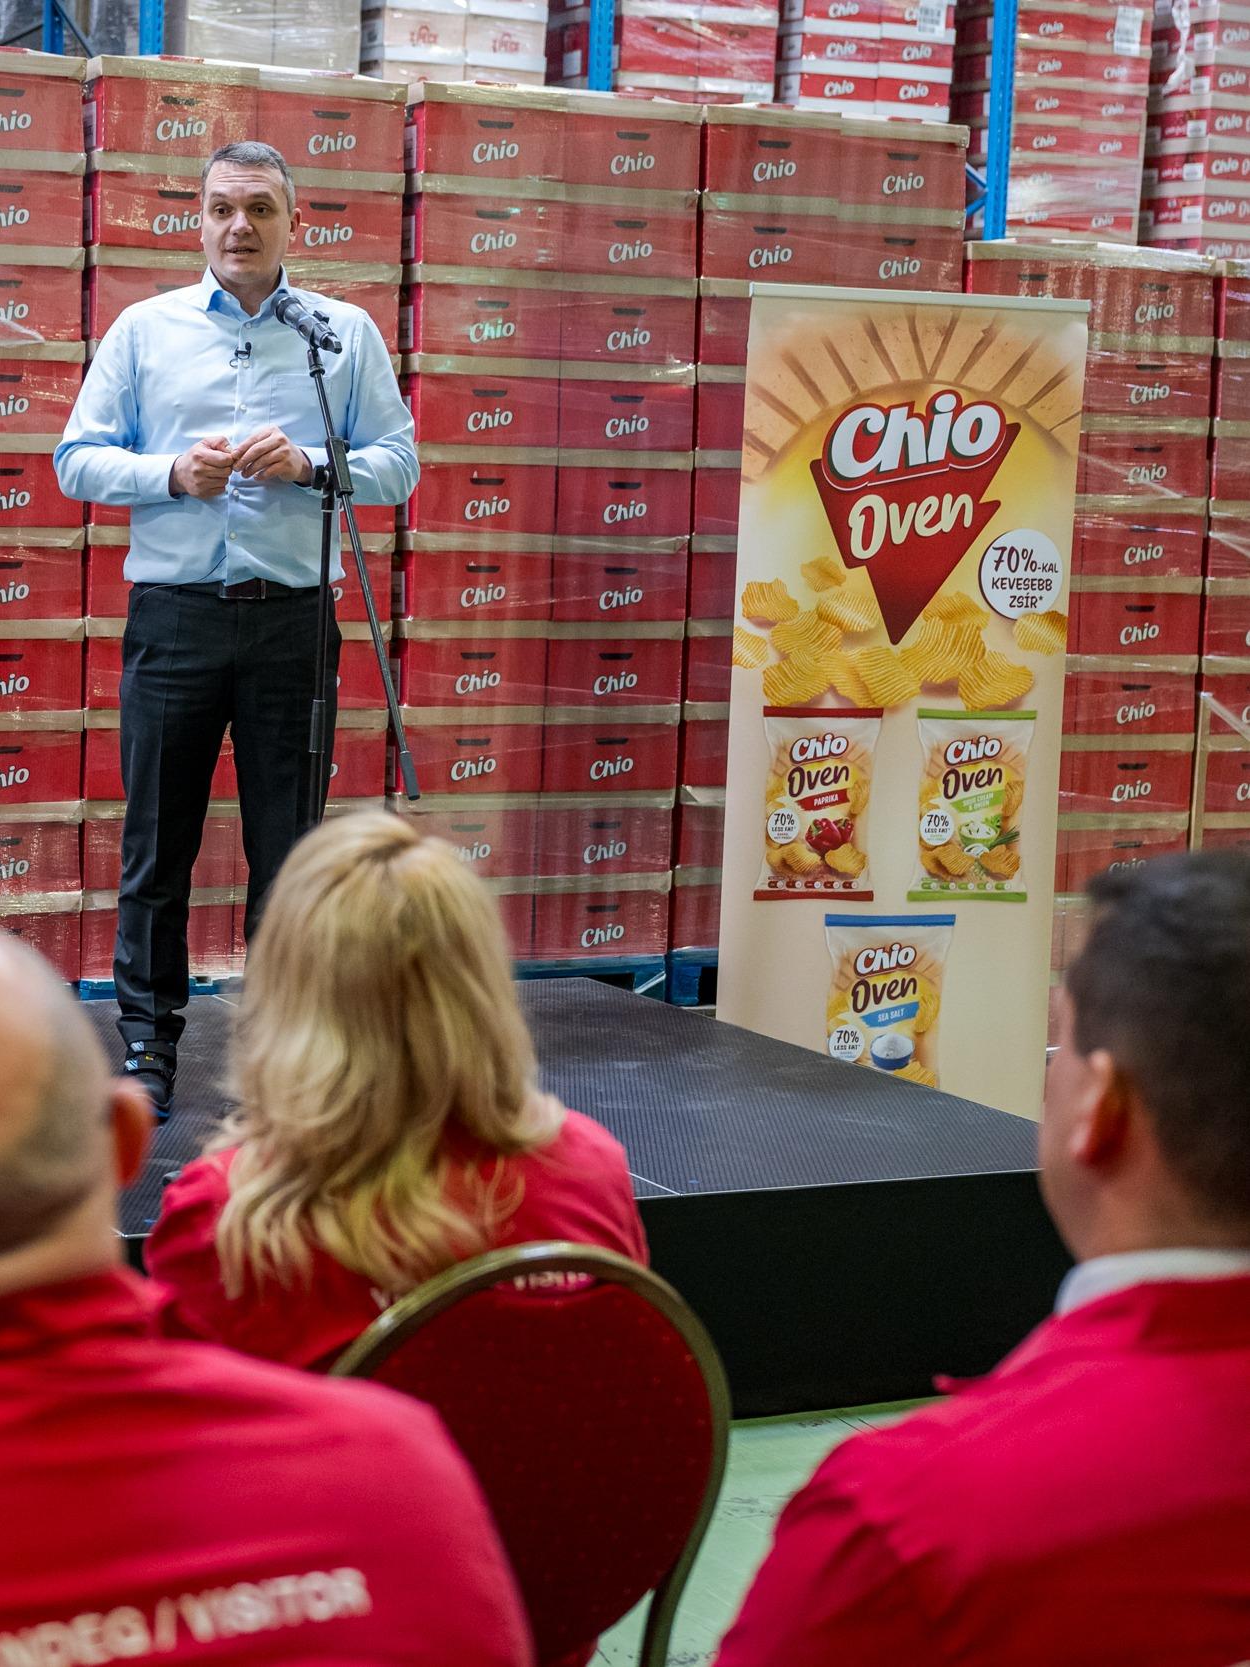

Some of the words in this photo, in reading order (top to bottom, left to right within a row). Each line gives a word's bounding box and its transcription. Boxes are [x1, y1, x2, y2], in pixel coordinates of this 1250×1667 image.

[828, 2, 859, 18] Chio
[826, 40, 857, 58] Chio
[902, 44, 932, 62] Chio
[824, 80, 855, 97] Chio
[899, 83, 929, 100] Chio
[156, 117, 207, 142] Chio
[307, 131, 357, 155] Chio
[472, 140, 520, 164] Chio
[610, 152, 656, 175] Chio
[752, 159, 797, 183] Chio
[882, 172, 925, 195] Chio
[152, 211, 201, 235] Chio
[304, 223, 353, 247] Chio
[470, 229, 518, 254] Chio
[608, 240, 653, 264] Chio
[748, 245, 793, 269] Chio
[878, 257, 921, 280] Chio
[1134, 300, 1174, 323] Chio
[469, 319, 516, 344] Chio
[606, 327, 651, 352] Chio
[1130, 383, 1170, 405] Chio
[467, 408, 513, 432] Chio
[605, 415, 649, 438] Chio
[830, 393, 1001, 478] Chio
[1128, 463, 1167, 485] Chio
[464, 496, 511, 521] Chio
[603, 499, 648, 524] Chio
[848, 493, 973, 560] Oven
[992, 546, 1059, 573] 70%-KAL
[1124, 542, 1164, 566] Chio
[991, 577, 1053, 591] KEVESEBB
[460, 585, 506, 608] Chio
[599, 588, 643, 610] Chio
[1119, 622, 1160, 646] Chio
[455, 672, 501, 695] Chio
[593, 670, 638, 696] Chio
[1115, 700, 1156, 725] Chio
[792, 733, 847, 762] Chio
[946, 736, 1001, 765] Chio
[450, 756, 497, 781] Chio
[589, 757, 634, 780] Chio
[788, 765, 849, 797] Oven
[942, 768, 1002, 799] Oven
[1111, 779, 1152, 803] Chio
[813, 794, 839, 807] PAPRIKA
[774, 813, 795, 826] 70%
[927, 814, 949, 827] 70%
[582, 839, 627, 865] Chio
[580, 922, 625, 948] Chio
[856, 943, 916, 975] Chio
[851, 977, 917, 1013] Oven
[878, 1013, 889, 1022] SEA
[891, 1008, 905, 1019] SALT
[836, 1030, 859, 1044] 70%
[180, 1567, 372, 1643] VISITOR
